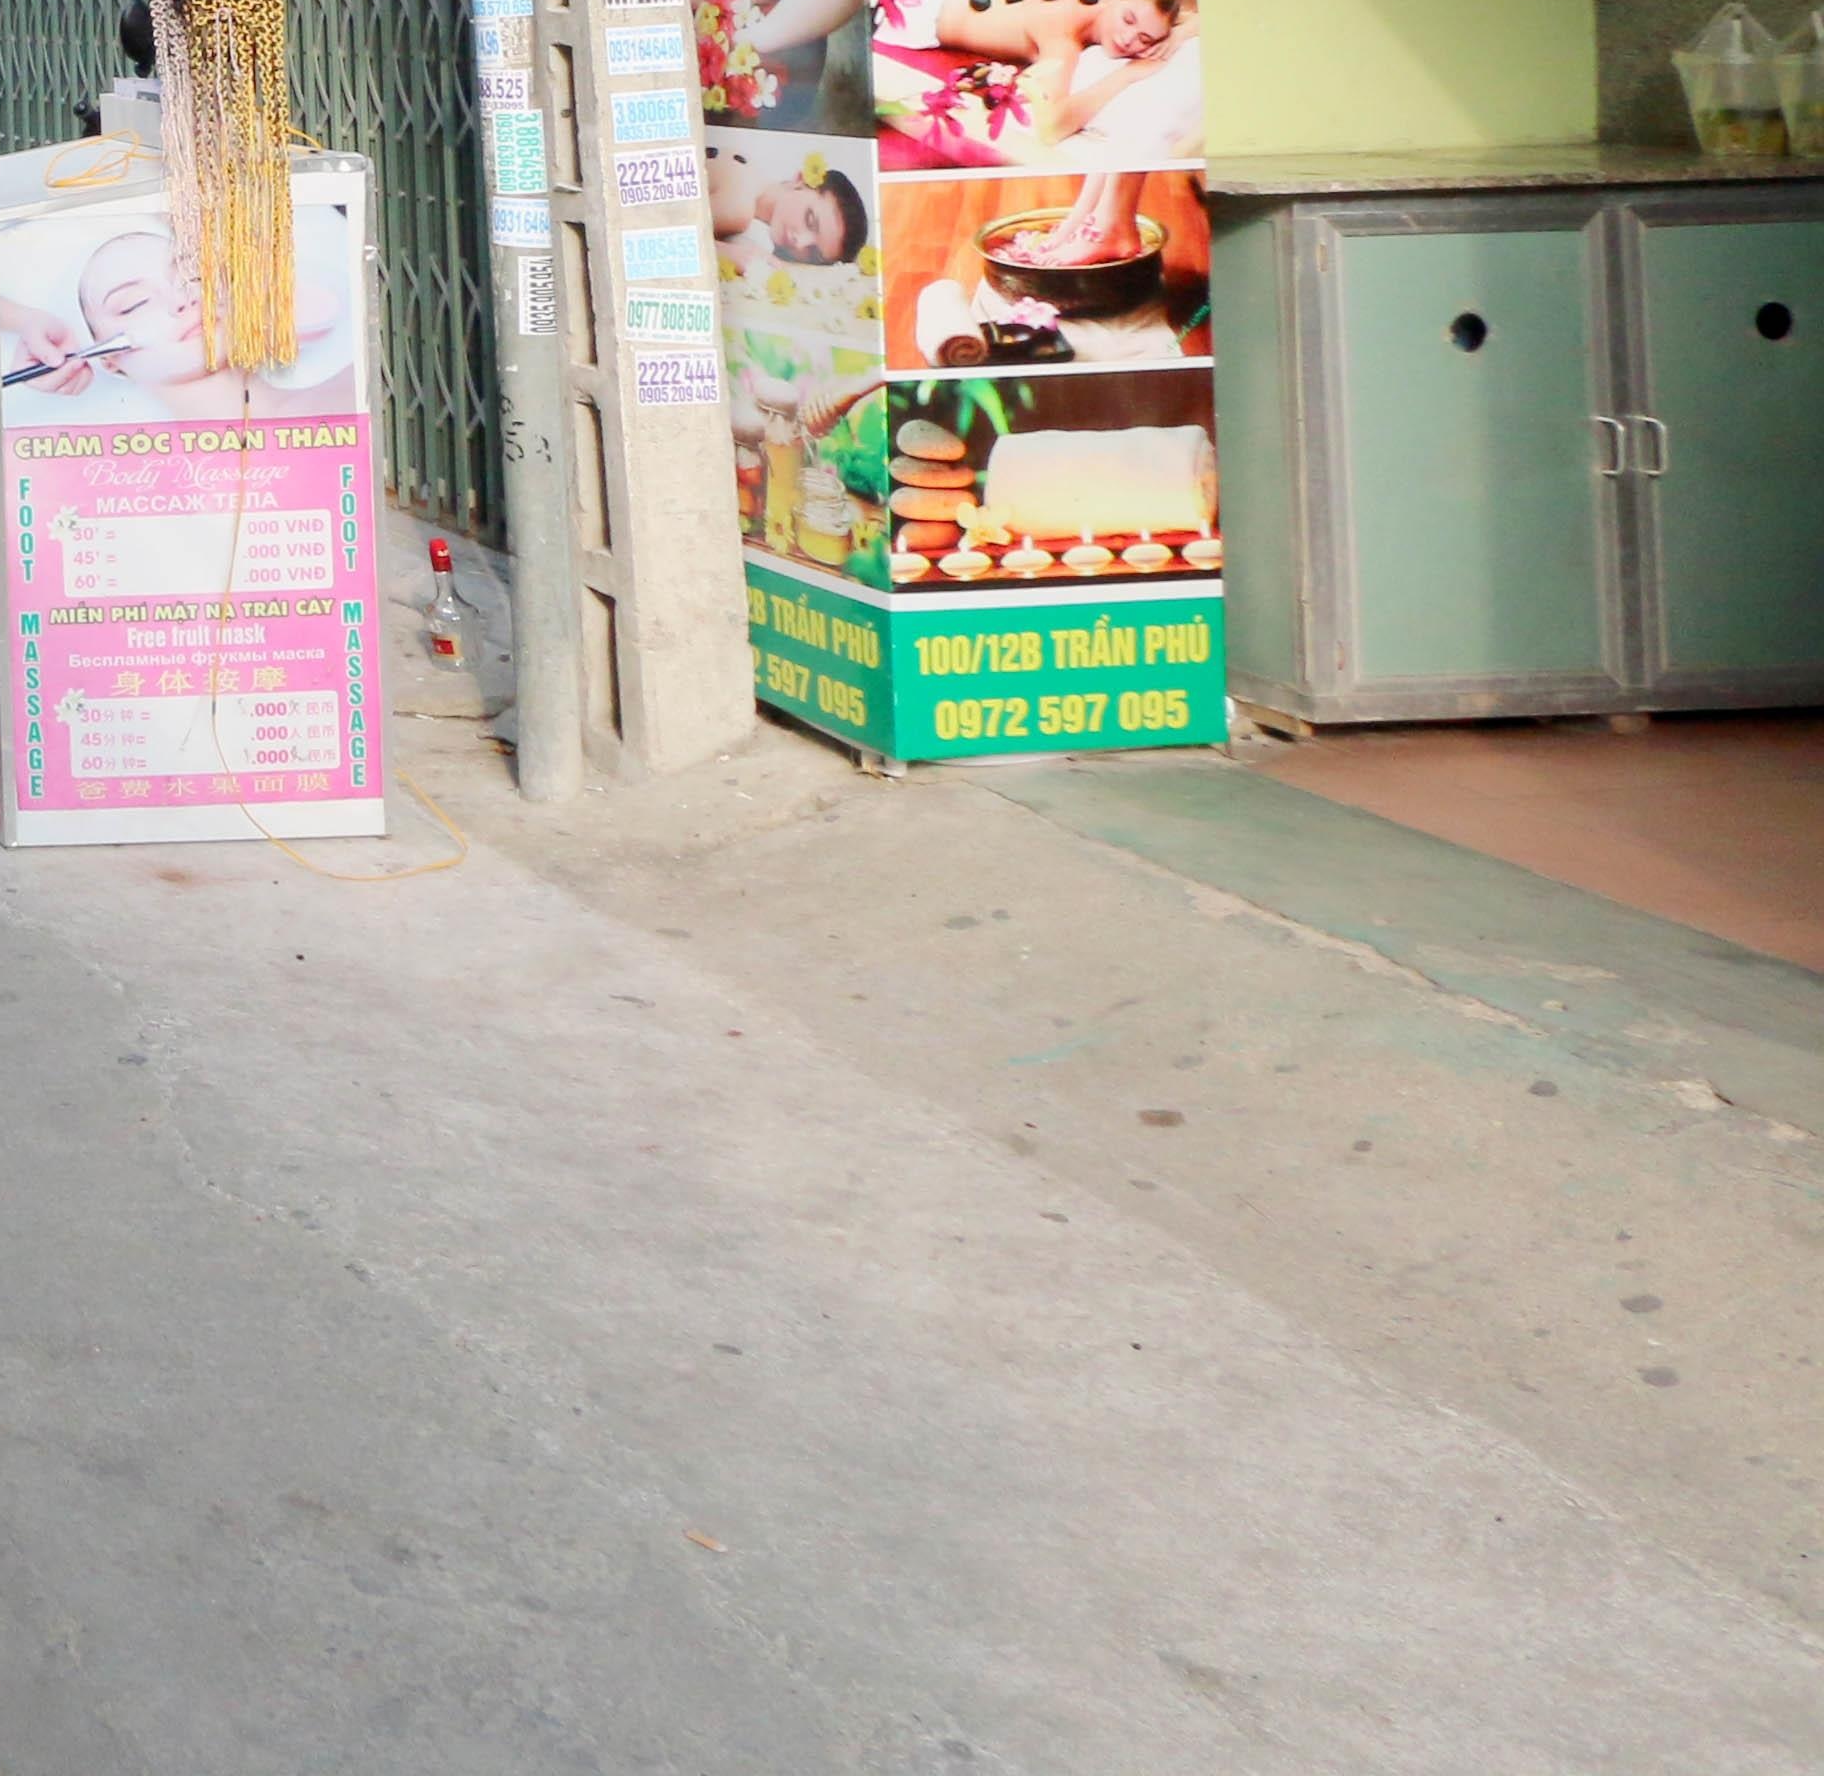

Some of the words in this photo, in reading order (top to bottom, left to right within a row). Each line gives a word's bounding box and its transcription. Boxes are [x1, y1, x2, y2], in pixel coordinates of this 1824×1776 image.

[617, 160, 663, 187] 2222
[664, 156, 696, 183] 444
[638, 361, 682, 386] 2222
[684, 359, 717, 385] 444
[180, 425, 265, 454] TOÀN
[273, 421, 358, 450] THÂN
[82, 457, 164, 493] Body
[166, 452, 291, 489] Massage
[96, 493, 206, 516] МАССАЖ
[214, 491, 279, 509] ТЕЛА
[340, 465, 358, 571] FOOT
[18, 477, 35, 583] FOOT
[127, 626, 167, 649] Free
[171, 625, 210, 647] fruit
[770, 592, 827, 650] TRẦN
[832, 621, 880, 669] PHÚ
[914, 633, 1043, 677] 100/12B
[1051, 613, 1136, 670] TRẦN
[1144, 615, 1211, 665] PHÚ
[20, 611, 44, 799] MASSAGE
[109, 665, 288, 697] 身体按摩
[341, 600, 367, 787] MASSAGE
[767, 654, 812, 704] 597
[818, 674, 868, 728] 095
[934, 698, 1030, 741] 0972
[1039, 694, 1109, 735] 597
[1119, 689, 1190, 732] 095
